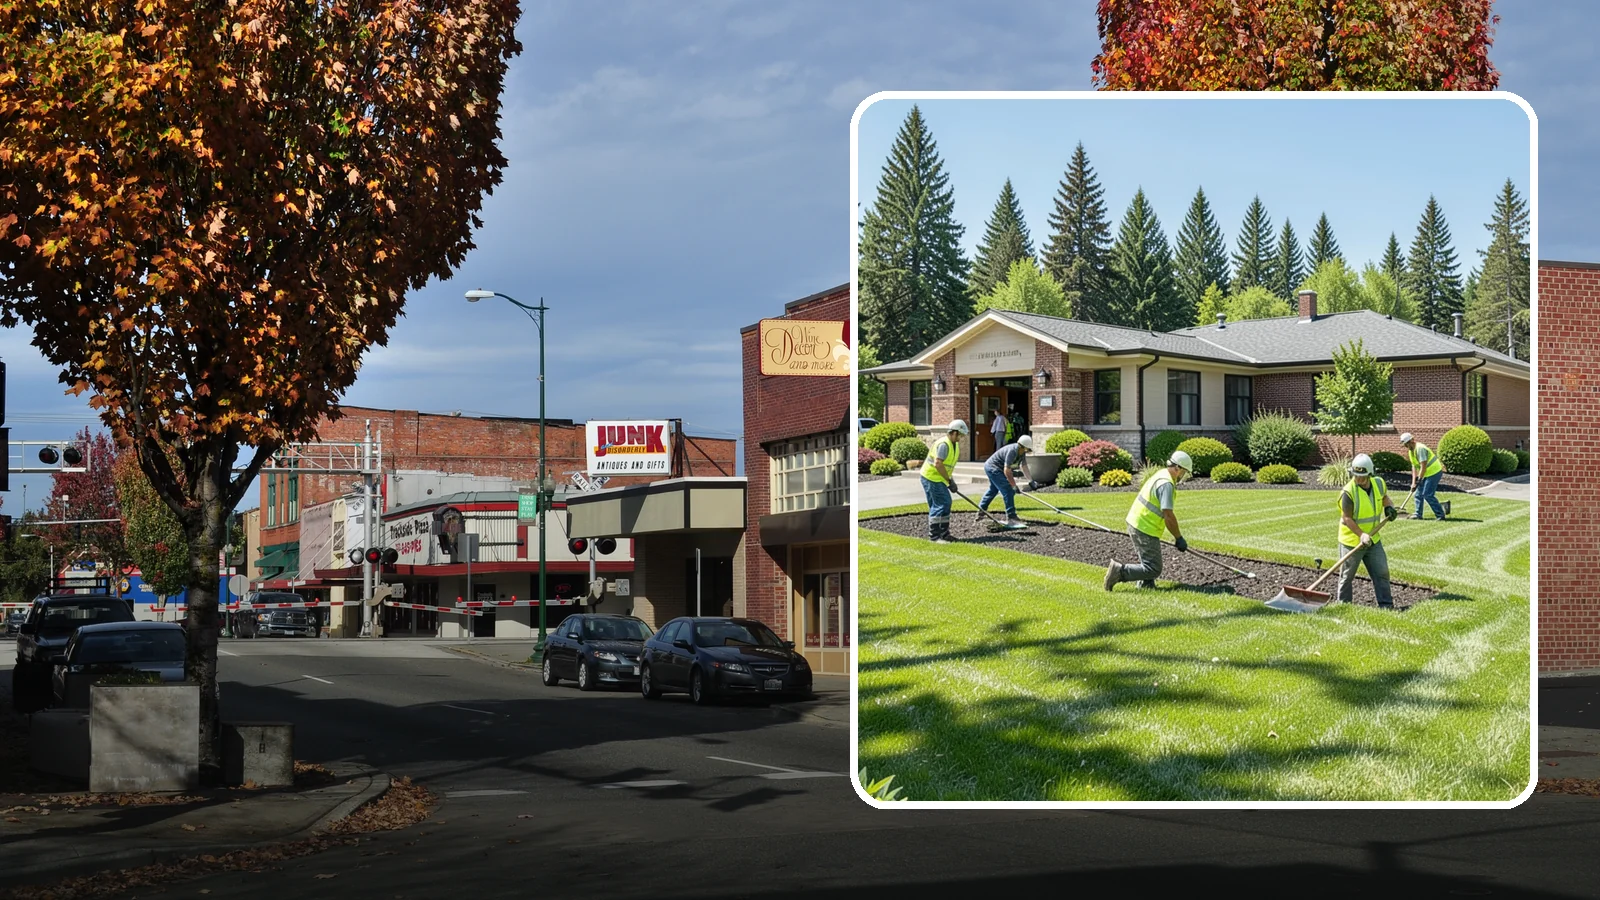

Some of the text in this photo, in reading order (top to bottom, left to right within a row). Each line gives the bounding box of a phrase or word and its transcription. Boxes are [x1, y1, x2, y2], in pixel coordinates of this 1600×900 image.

[765, 327, 831, 365] Decor
[595, 425, 665, 457] JUNK
[597, 461, 665, 469] ANTIQUES AND GIFTS
[414, 519, 429, 534] Pizza
